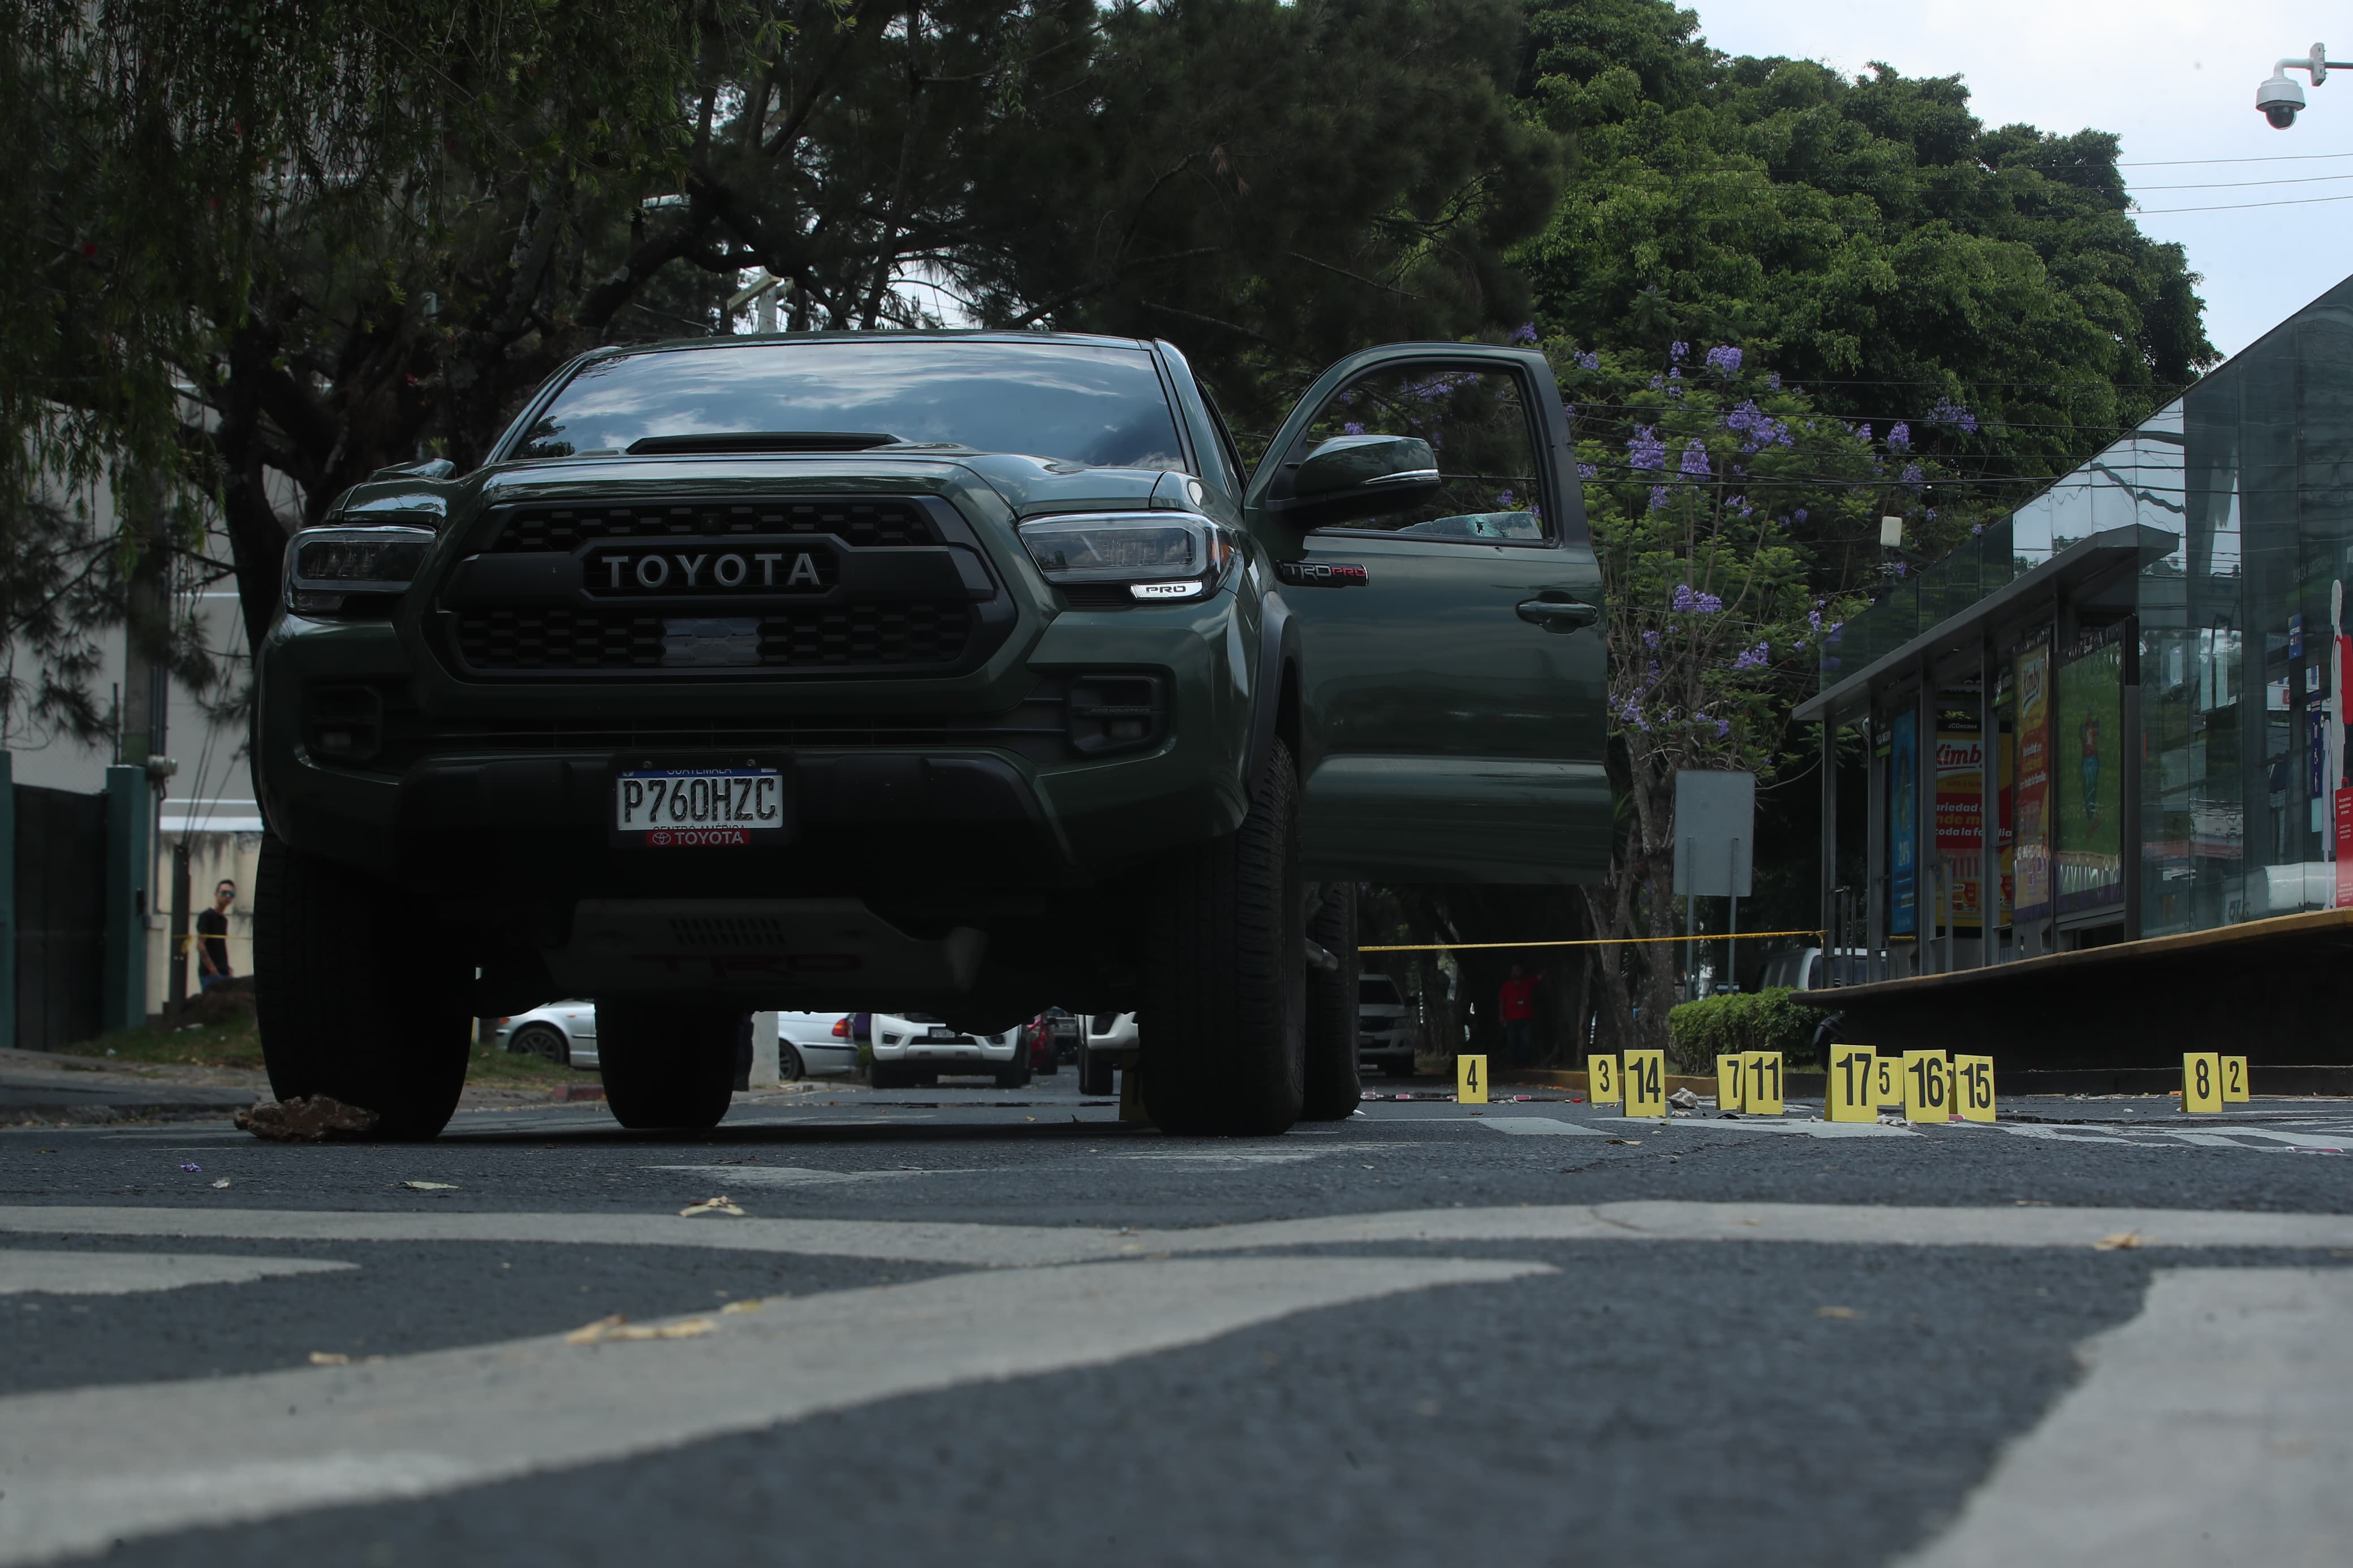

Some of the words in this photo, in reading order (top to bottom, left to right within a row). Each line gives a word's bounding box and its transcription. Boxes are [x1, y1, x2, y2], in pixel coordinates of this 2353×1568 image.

[602, 553, 821, 589] TOYOTA
[1283, 563, 1332, 581] TRD
[1331, 567, 1367, 577] PRO
[1145, 585, 1187, 594] PRO
[1936, 744, 1982, 768] Kimb
[624, 777, 776, 822] P760HZC
[1936, 802, 1978, 812] ariedad
[675, 831, 744, 845] TOYOTA
[1962, 827, 1972, 836] la
[1466, 1059, 1479, 1094] 4
[1598, 1060, 1610, 1092] 3
[1628, 1056, 1661, 1104] 14
[1727, 1060, 1740, 1099] 7
[1749, 1056, 1779, 1102] 11
[1836, 1052, 1872, 1107] 17
[1878, 1061, 1890, 1095] 5
[1908, 1057, 1945, 1108] 16
[1960, 1063, 1990, 1109] 15
[2196, 1058, 2209, 1100] 8
[2229, 1061, 2240, 1092] 2
